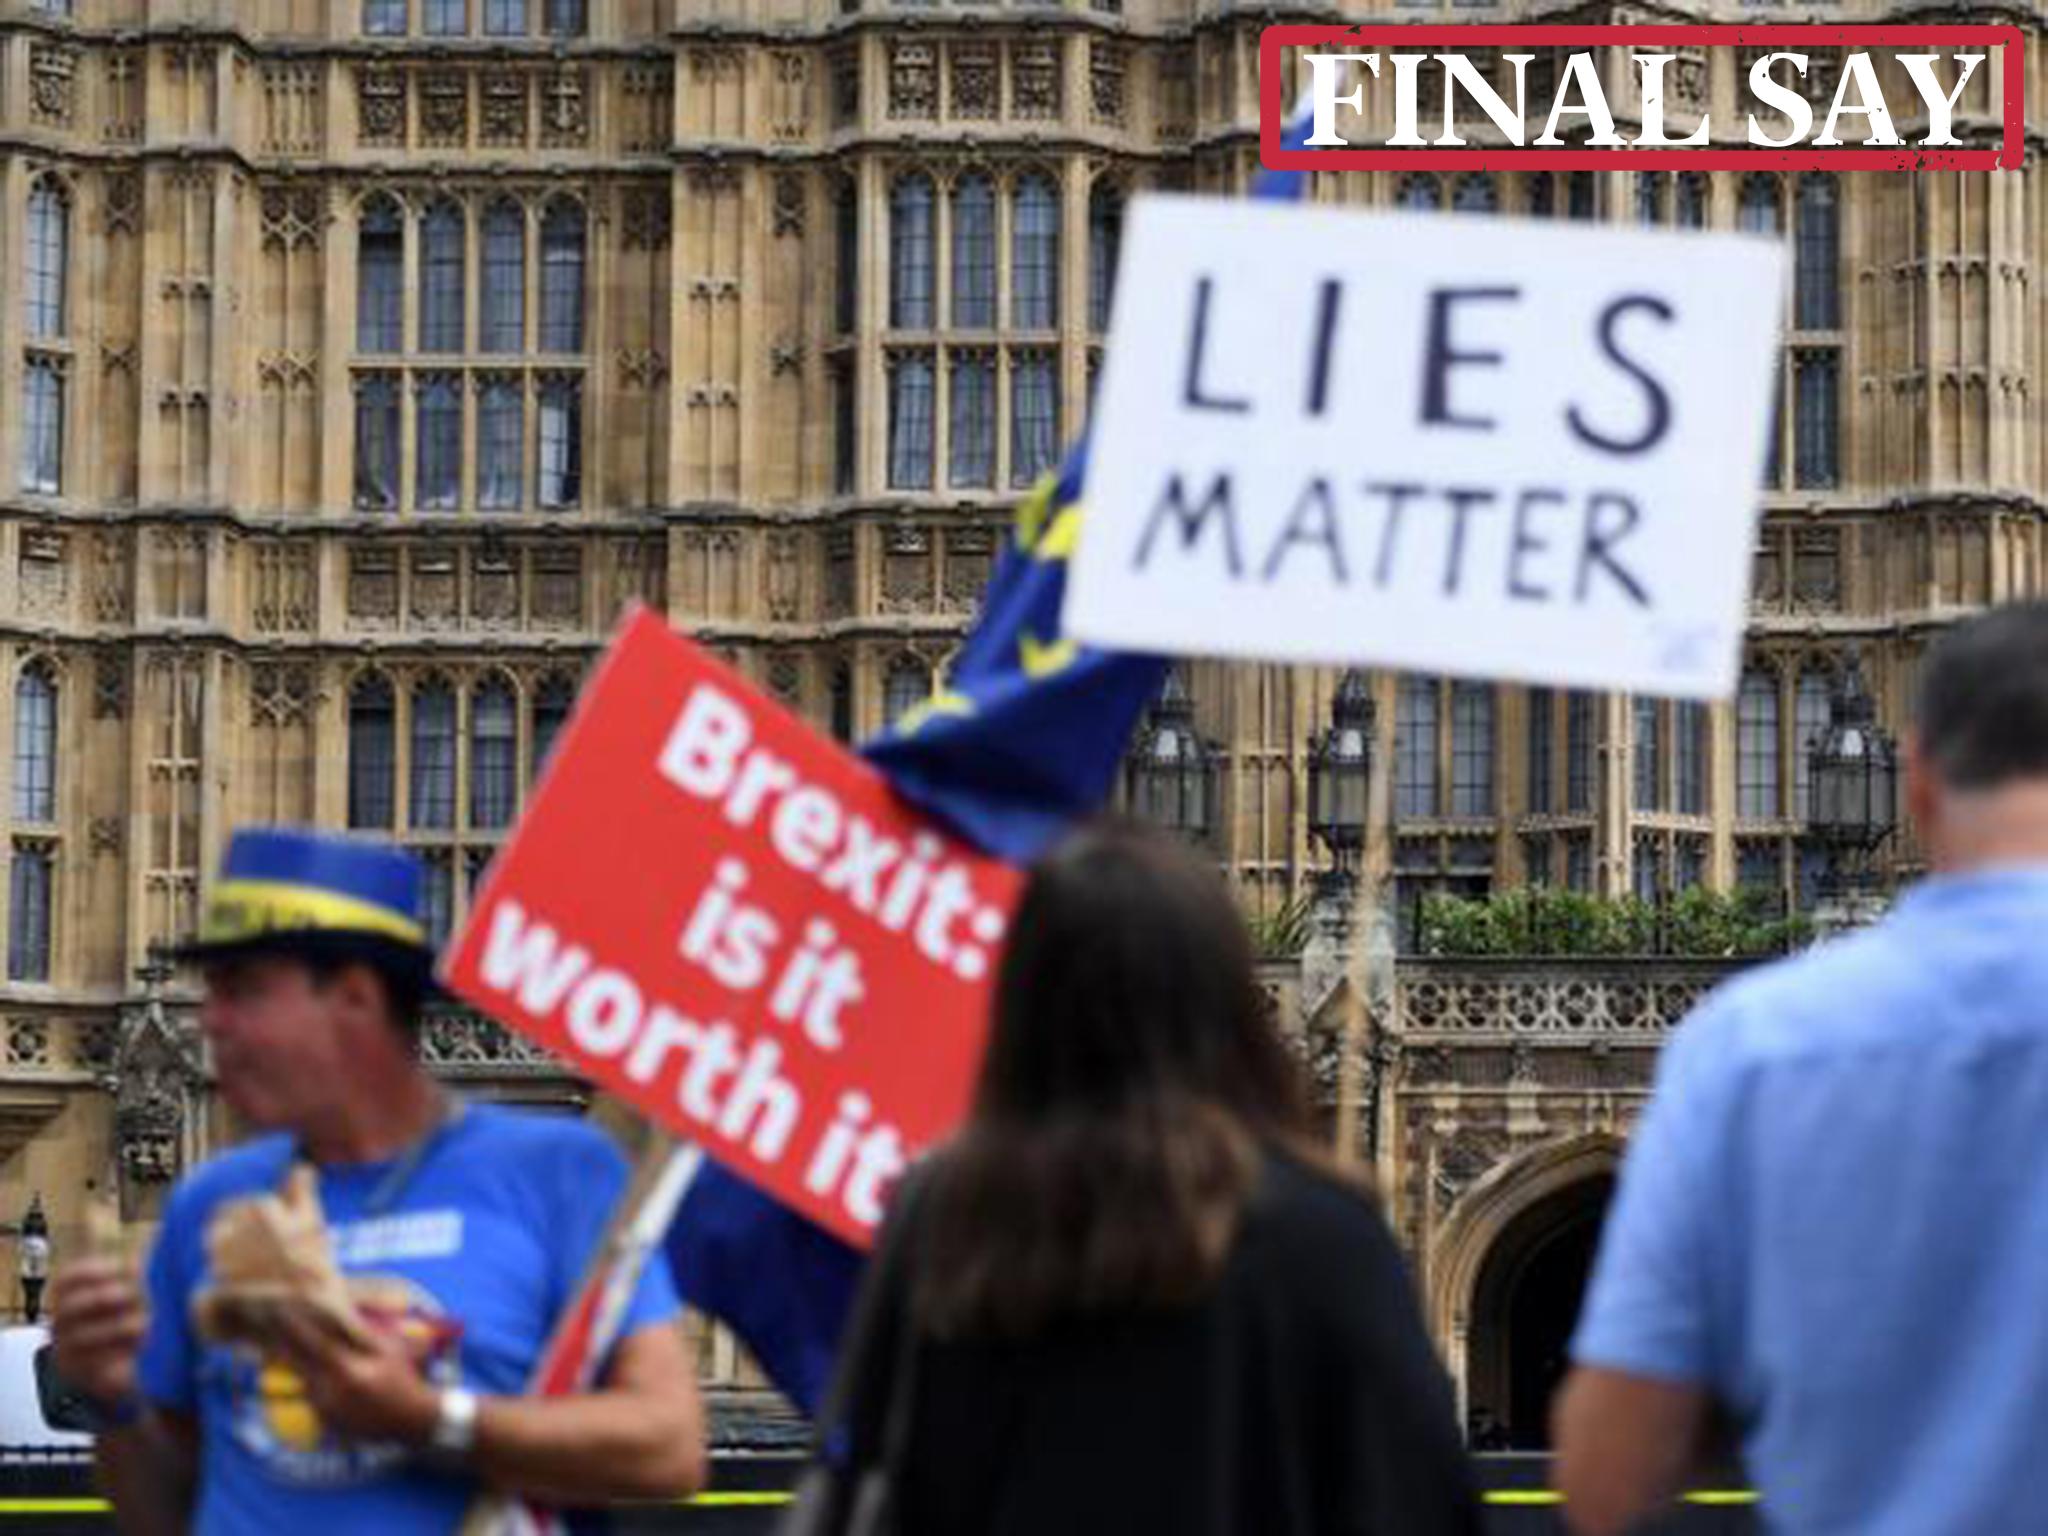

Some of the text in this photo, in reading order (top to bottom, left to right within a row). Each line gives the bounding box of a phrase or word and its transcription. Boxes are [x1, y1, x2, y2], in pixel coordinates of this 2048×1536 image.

[1181, 277, 1677, 458] LIES
[1132, 470, 1653, 609] MATTER
[657, 682, 1003, 980] Brexit:
[480, 902, 802, 1162] worth
[679, 859, 864, 1049] is it
